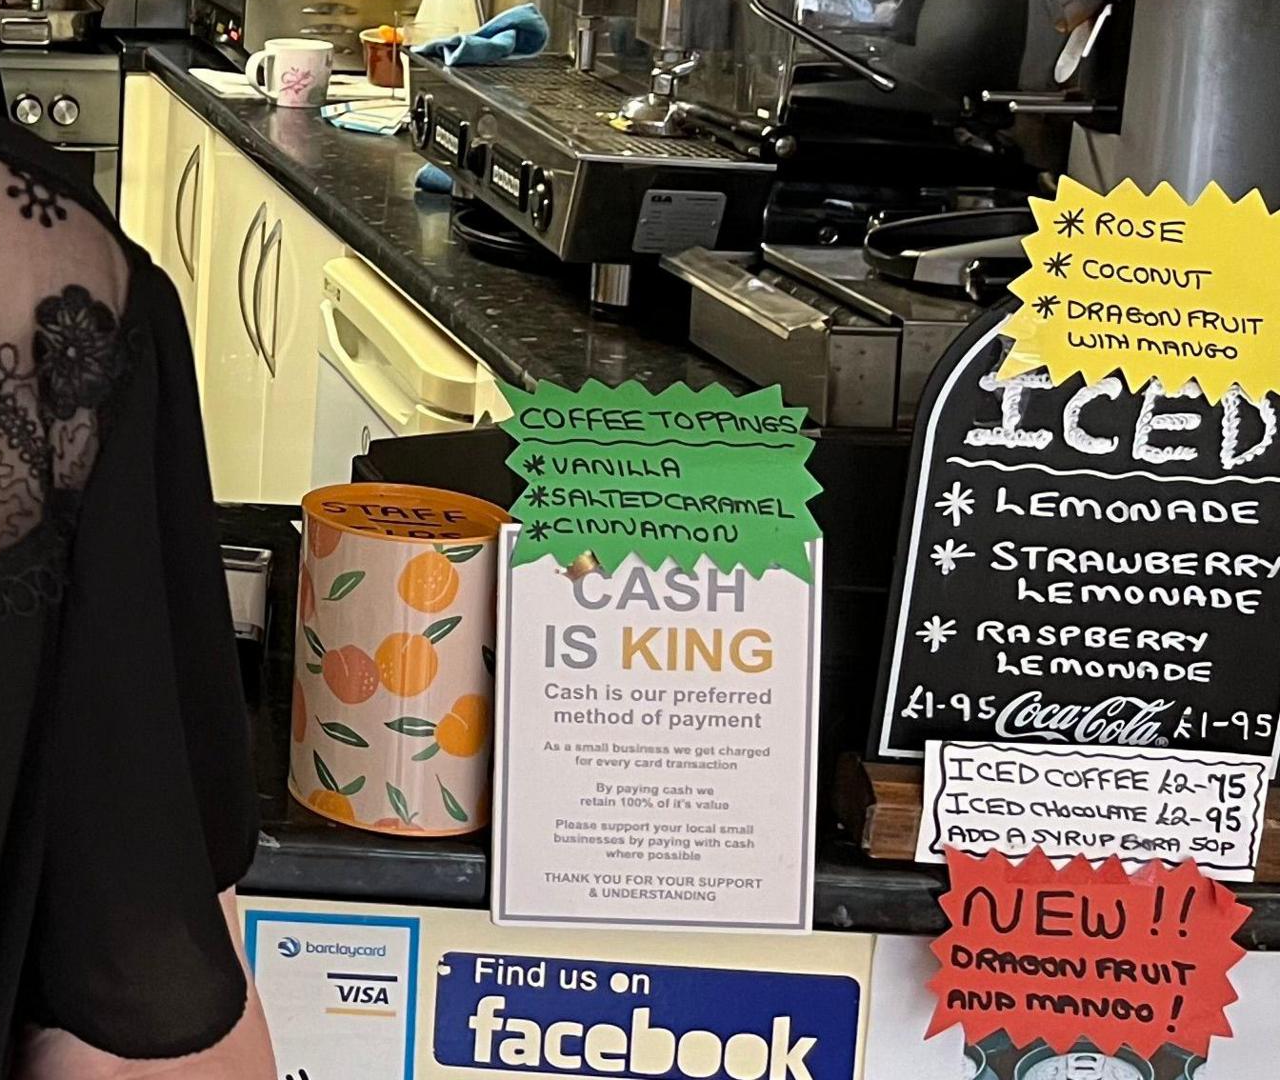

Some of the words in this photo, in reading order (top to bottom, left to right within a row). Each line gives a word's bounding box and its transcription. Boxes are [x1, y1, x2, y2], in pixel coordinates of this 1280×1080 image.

[1096, 213, 1186, 243] ROSE
[1082, 259, 1213, 289] COCONUT
[1067, 300, 1181, 328] DRAGON
[1188, 311, 1263, 335] FRUIT
[1068, 332, 1130, 350] WITH
[1137, 338, 1238, 360] MANGO
[520, 407, 645, 431] COFFEE
[647, 409, 799, 434] TOPPINGS
[964, 370, 1279, 469] ICED
[552, 457, 681, 479] VANILLA
[321, 501, 468, 524] STAFF
[995, 487, 1260, 524] LEMONADE
[553, 518, 738, 544] CINNAMON
[990, 541, 1280, 579] STRAWBERRY
[572, 566, 746, 613] CASH
[1017, 578, 1263, 614] LEMONADE
[544, 625, 598, 670] IS
[621, 626, 774, 674] KING
[976, 620, 1208, 652] RASPBERRY
[996, 652, 1214, 683] LEMONADE
[544, 683, 598, 702] Cash
[605, 684, 623, 702] is
[630, 689, 667, 702] our
[673, 686, 772, 706] preferred
[553, 708, 634, 725] method
[640, 709, 664, 726] of
[668, 711, 762, 730] payment
[901, 685, 996, 722] £1-95
[995, 690, 1175, 746] Coca-Cola
[1173, 707, 1273, 740] £1-95
[544, 741, 560, 752] As
[575, 742, 608, 753] small
[612, 744, 670, 755] business
[673, 747, 691, 756] we
[695, 747, 715, 758] get
[719, 746, 770, 758] charged
[575, 756, 592, 767] for
[596, 757, 631, 769] every
[634, 757, 663, 768] card
[666, 758, 738, 770] transaction
[596, 783, 613, 795] By
[616, 784, 659, 797] paying
[663, 785, 692, 795] cash
[696, 787, 715, 796] we
[948, 758, 1040, 783] ICED
[1044, 769, 1150, 792] COFFEE
[1157, 770, 1246, 803] £2-75
[580, 797, 616, 807] retain
[620, 798, 653, 808] 100%
[657, 798, 671, 809] of
[673, 799, 691, 809] it's
[696, 799, 729, 810] value
[945, 793, 1025, 816] ICED
[1030, 800, 1148, 823] CHOCOLATE
[1155, 802, 1242, 832] £2-95
[555, 819, 597, 831] Please
[601, 821, 650, 832] support
[653, 824, 682, 834] your
[686, 823, 716, 834] local
[720, 824, 754, 835] small
[947, 826, 1001, 844] ADD
[1006, 827, 1027, 844] A
[1032, 830, 1115, 850] SYRUP
[553, 833, 625, 845] businesses
[628, 835, 643, 848] by
[648, 837, 691, 849] paying
[694, 837, 721, 849] with
[725, 838, 755, 849] cash
[606, 849, 644, 860] where
[648, 851, 701, 862] possible
[545, 872, 590, 884] THANK
[593, 874, 621, 885] YOU
[626, 875, 653, 886] FOR
[657, 876, 694, 887] YOUR
[698, 877, 763, 889] SUPPORT
[588, 887, 598, 898] &
[602, 888, 717, 902] UNDERSTANDING
[306, 941, 387, 958] barclaycard
[475, 958, 545, 988] Find
[559, 966, 598, 990] us
[610, 971, 650, 995] on
[951, 945, 1087, 978] DRAGON
[1095, 957, 1197, 986] FRUIT
[335, 984, 389, 1005] VISA
[947, 989, 1017, 1011] AND
[469, 995, 819, 1080] facebook
